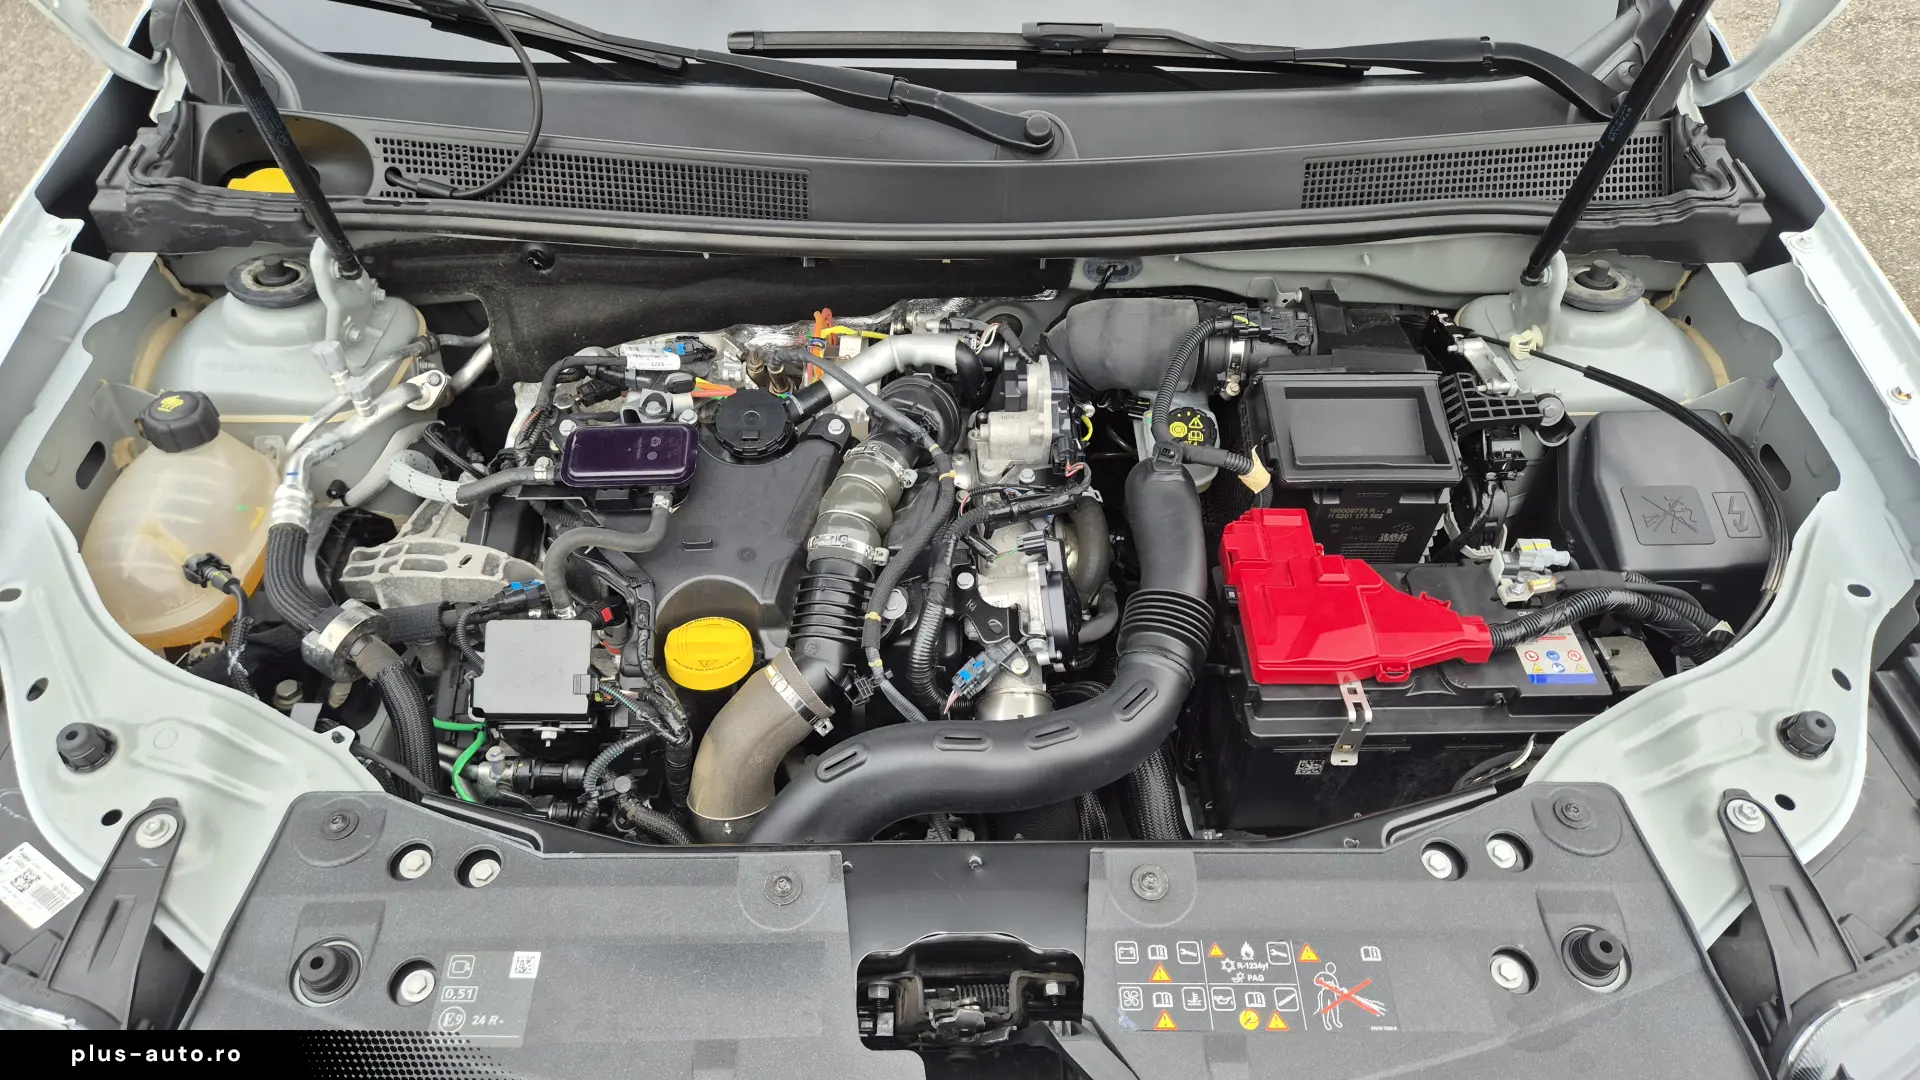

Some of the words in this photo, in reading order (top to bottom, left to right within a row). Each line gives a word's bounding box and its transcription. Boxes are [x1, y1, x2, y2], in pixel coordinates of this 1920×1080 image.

[1247, 974, 1265, 982] PAG
[445, 988, 474, 1000] 0,51
[443, 1012, 464, 1027] E9
[471, 1015, 486, 1026] 24
